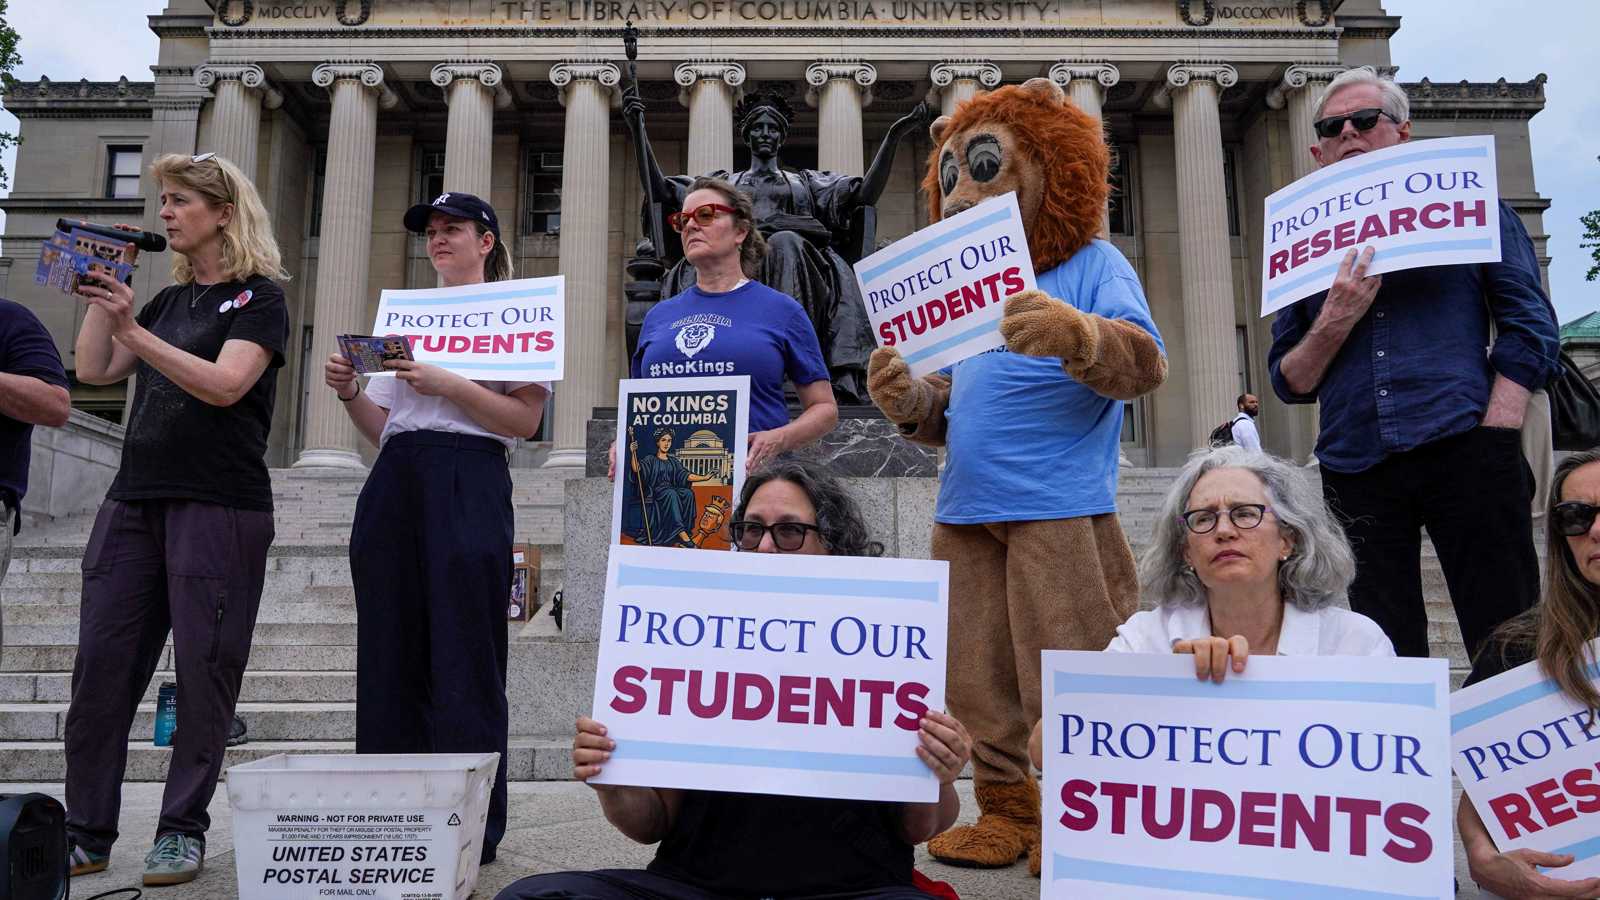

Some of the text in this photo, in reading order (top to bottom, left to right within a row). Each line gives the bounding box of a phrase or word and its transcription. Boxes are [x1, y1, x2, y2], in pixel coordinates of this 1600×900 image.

[257, 6, 330, 19] MDCCLIV
[504, 1, 1048, 21] THE LIBRARY OF COLUMBIA UNIVERSITY
[1216, 6, 1294, 20] MDCCCXCVII
[1270, 170, 1483, 244] PROTECT OUR
[1269, 199, 1486, 280] RESEARCH
[868, 235, 1017, 314] PROTECT OUR
[385, 306, 554, 328] PROTECT OUR
[879, 266, 1025, 347] STUDENTS
[384, 331, 555, 354] TUDENTS
[649, 360, 735, 377] #NoKings
[633, 394, 729, 413] NO KINGS
[633, 413, 728, 426] AT COLUMBIA
[615, 604, 933, 660] PROTECT OUR
[609, 665, 930, 731] STUDENTS
[1058, 713, 1432, 778] PROTECT OUR
[1459, 709, 1600, 782] PROTE
[1488, 761, 1600, 840] RES
[277, 814, 319, 823] WARNING
[326, 814, 345, 823] NOT
[347, 814, 366, 823] FOR
[367, 814, 405, 823] PRIVATE
[406, 814, 425, 823] USE
[1058, 778, 1433, 864] STUDENTS
[272, 846, 428, 862] UNITED STATES
[263, 868, 435, 884] POSTAL SERVICE
[319, 888, 377, 896] FOR MAIL ONLY
